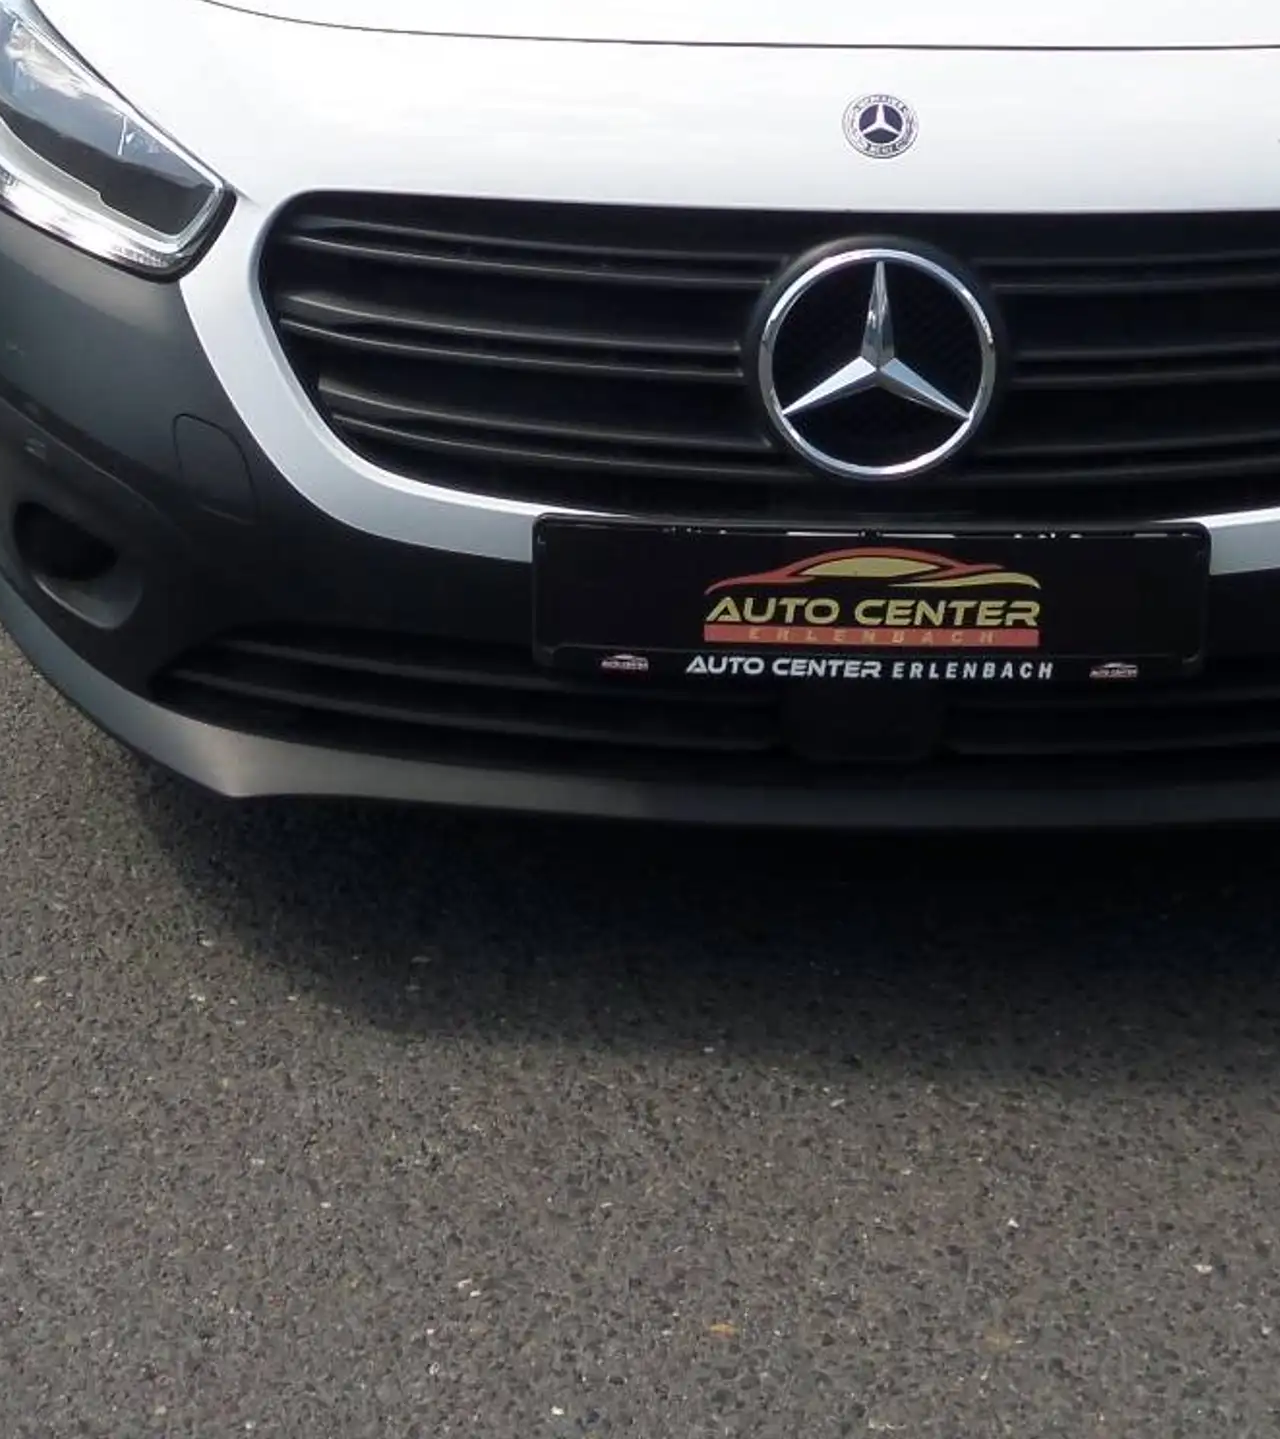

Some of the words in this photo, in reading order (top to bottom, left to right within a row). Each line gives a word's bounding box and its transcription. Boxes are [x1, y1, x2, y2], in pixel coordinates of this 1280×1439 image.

[705, 596, 841, 625] AUTO
[854, 598, 1042, 628] CENTER
[748, 628, 997, 646] ERLENBACH
[685, 655, 766, 677] AUTO
[771, 657, 883, 679] CENTER
[891, 661, 1055, 681] ERLENBACH
